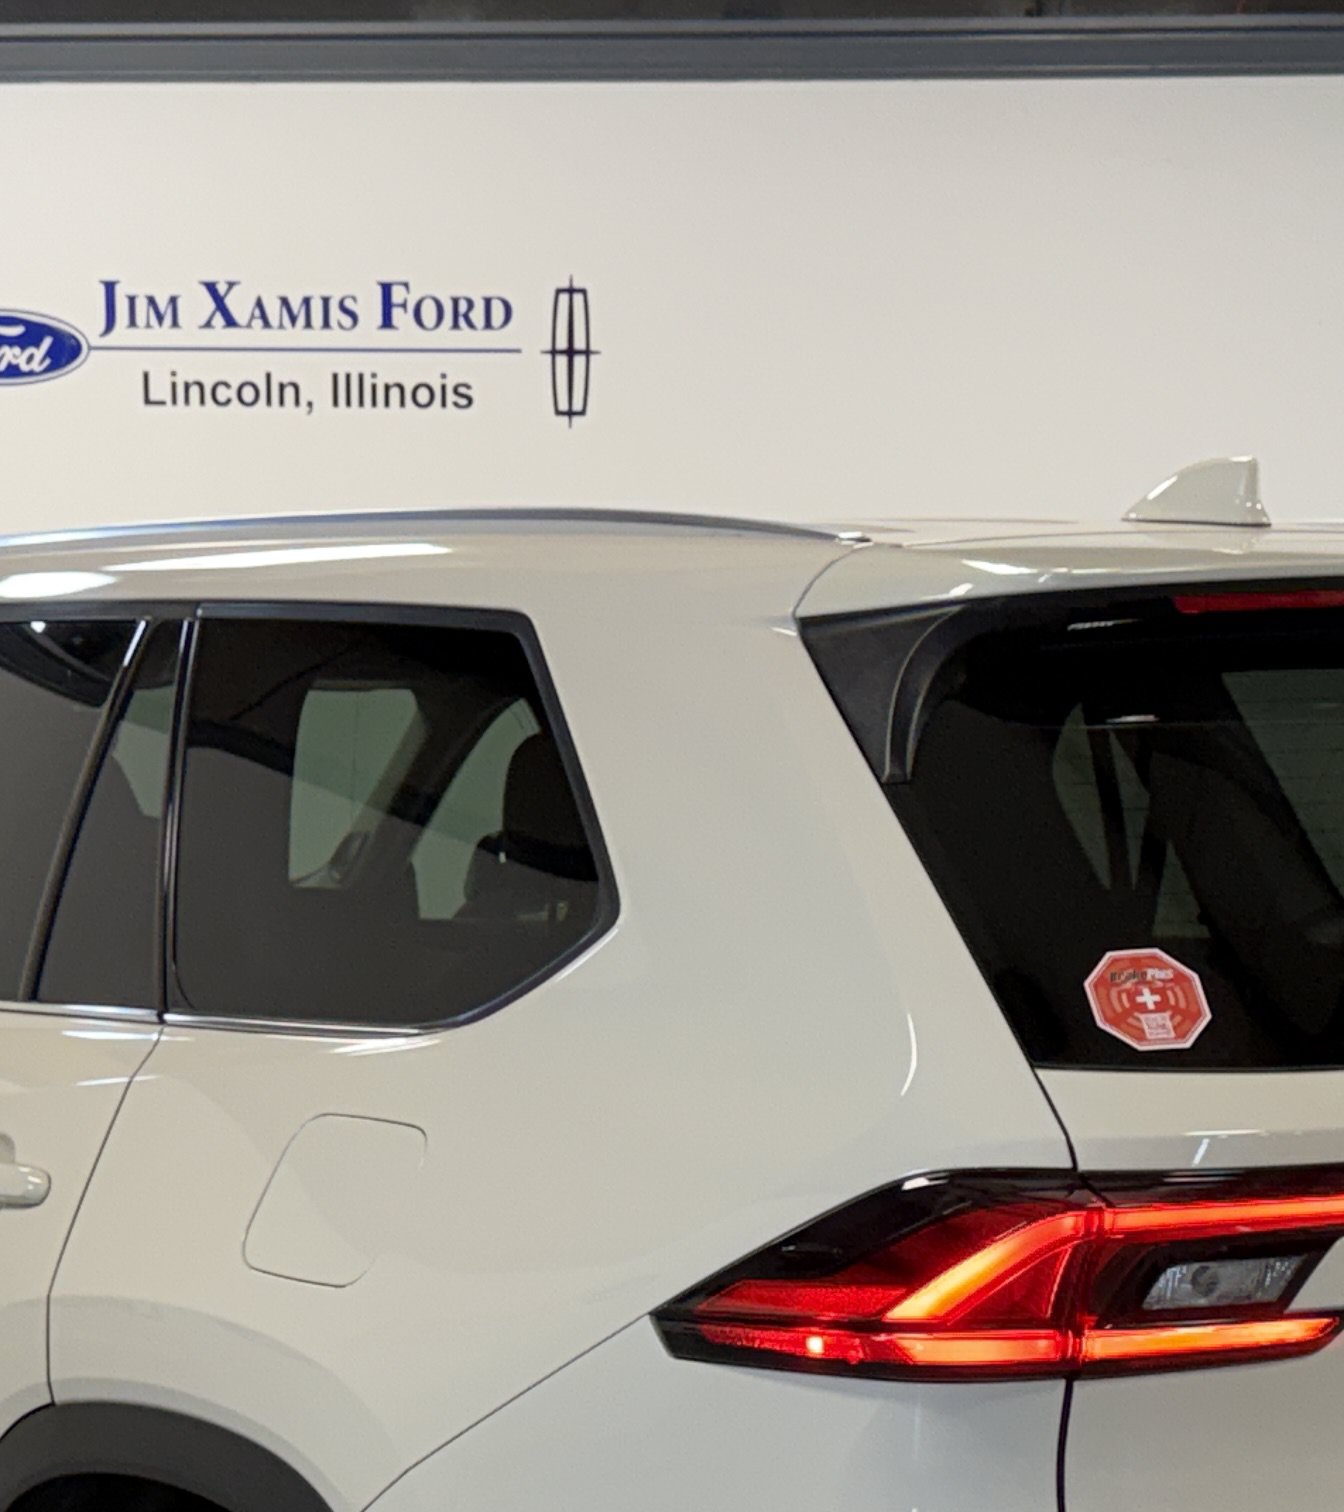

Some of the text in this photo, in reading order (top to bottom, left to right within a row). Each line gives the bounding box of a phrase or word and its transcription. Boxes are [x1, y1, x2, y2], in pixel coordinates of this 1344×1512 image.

[98, 279, 514, 338] JIM XAMIS FORD
[142, 370, 475, 416] Lincoln, Illinois
